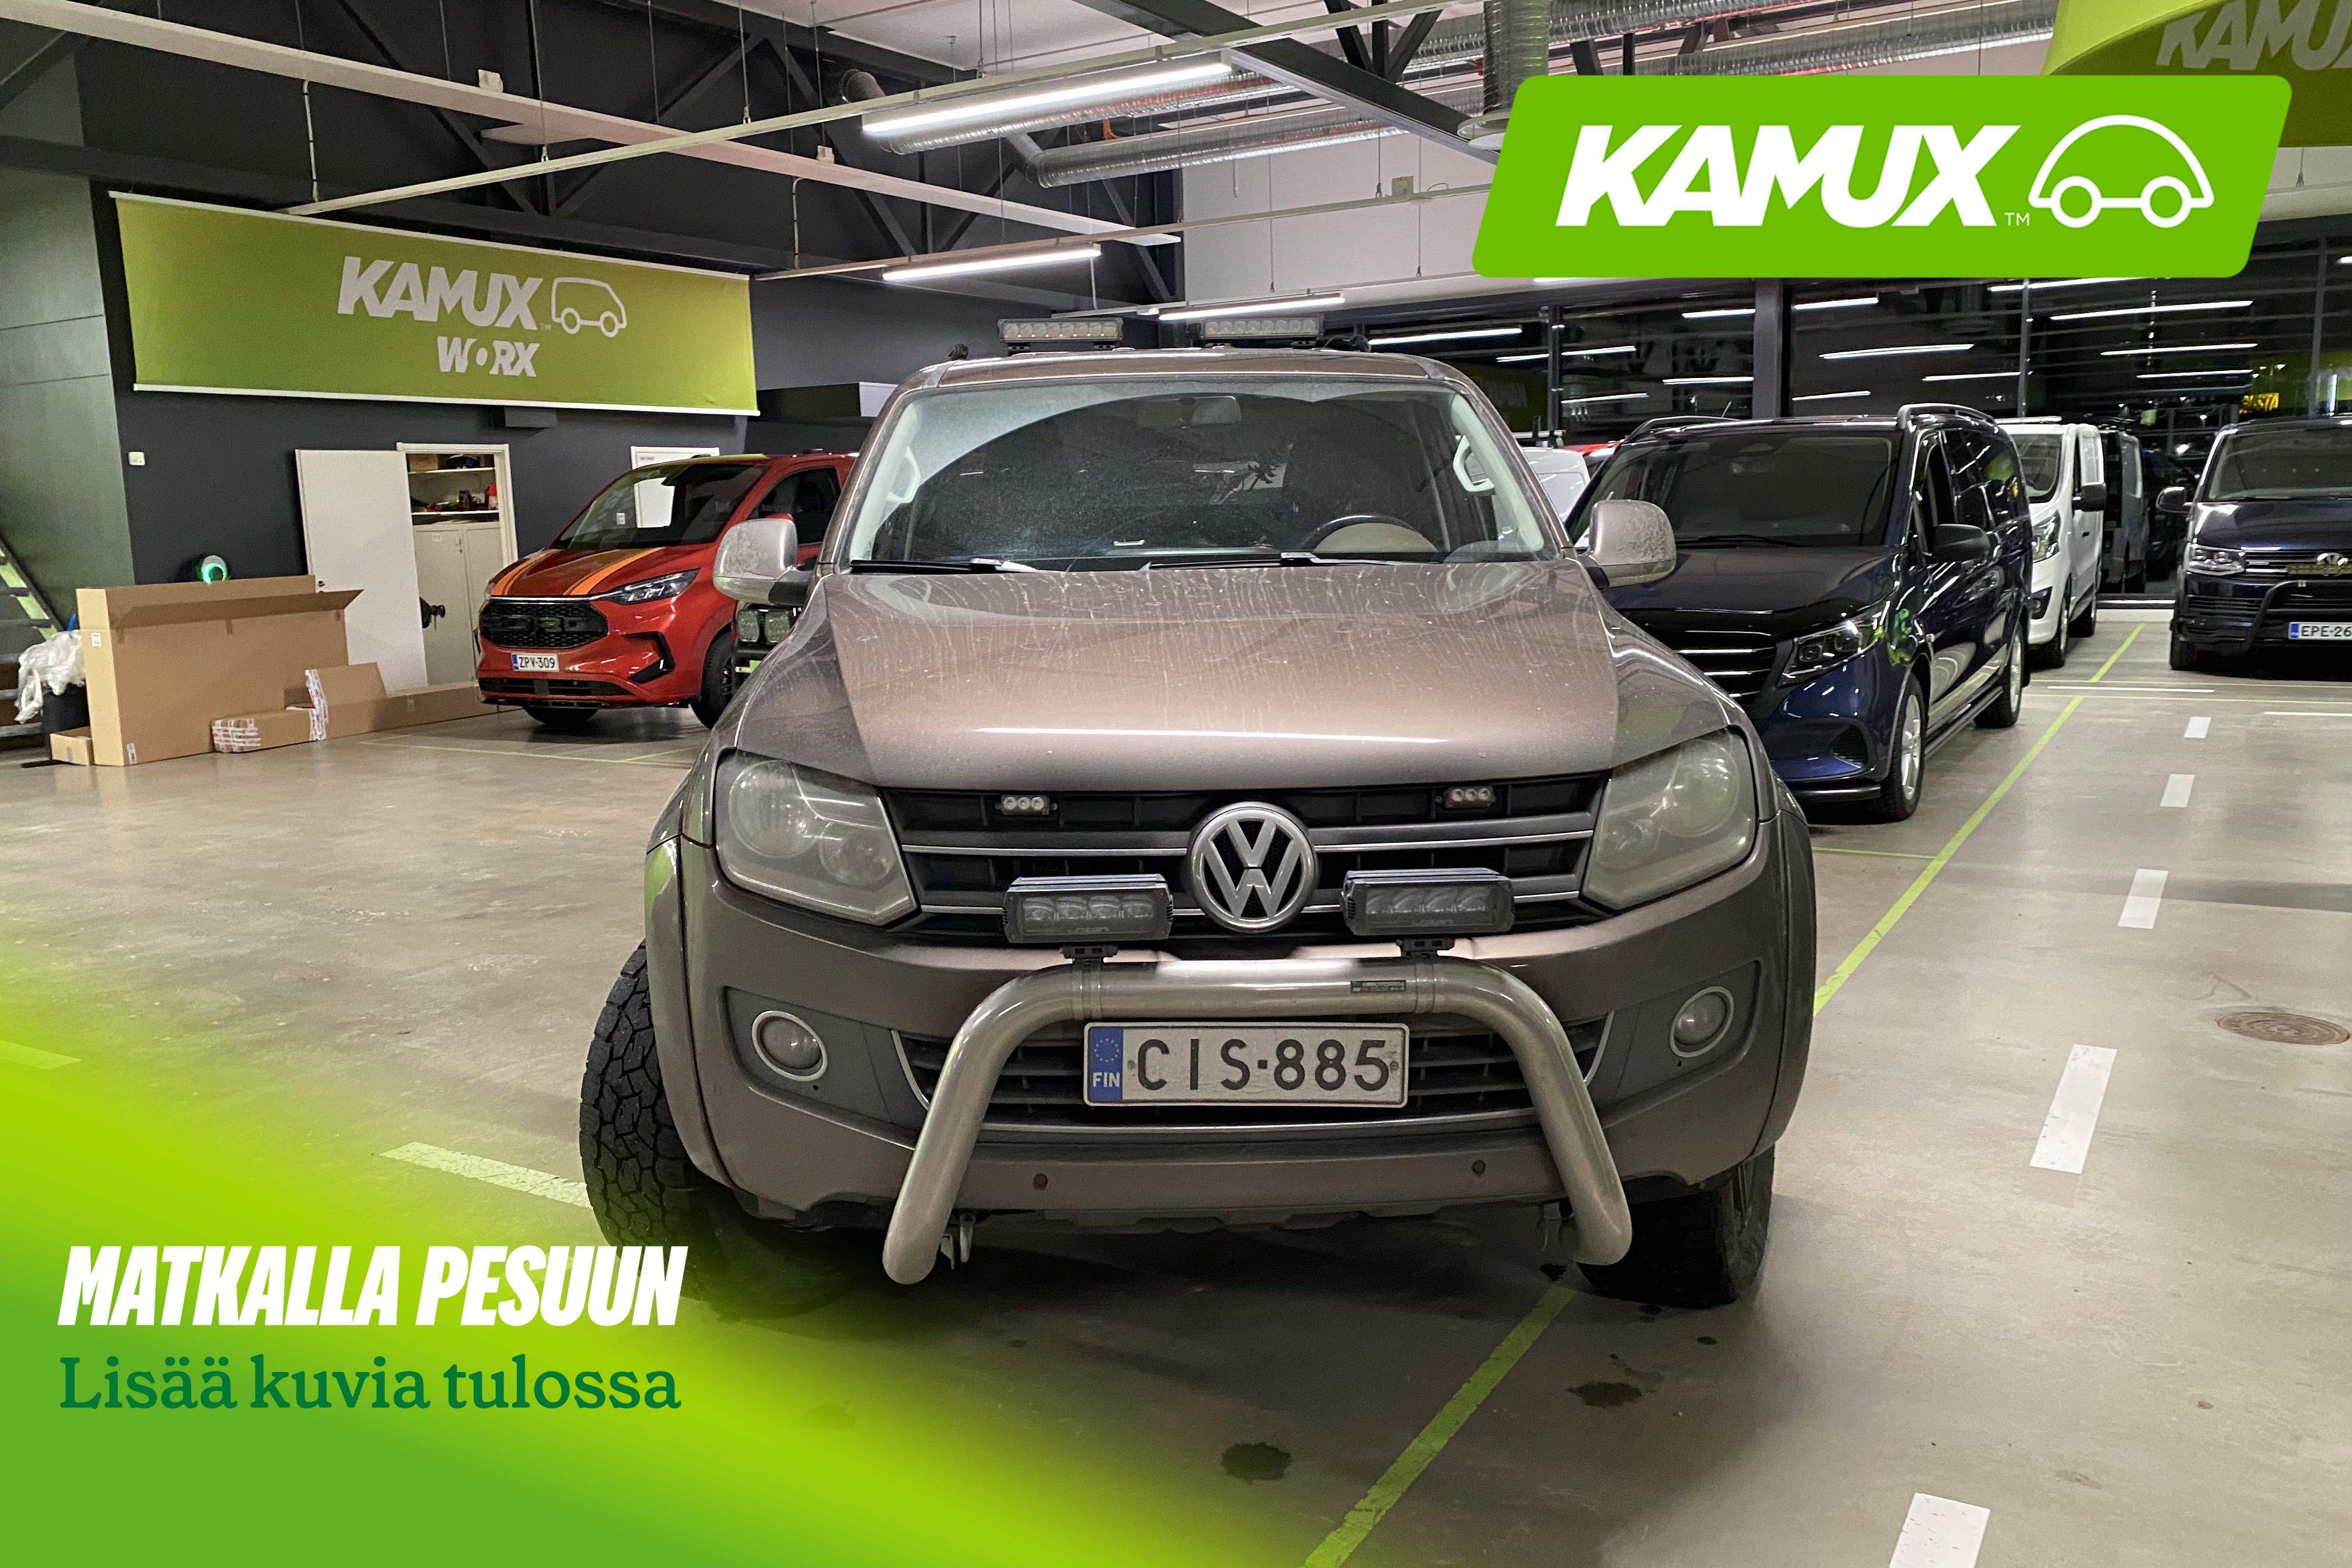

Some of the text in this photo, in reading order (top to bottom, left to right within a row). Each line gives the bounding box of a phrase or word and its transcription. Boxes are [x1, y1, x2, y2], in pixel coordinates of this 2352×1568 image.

[2156, 0, 2352, 71] KAMU
[337, 256, 542, 330] KAMUX
[1092, 1072, 1120, 1087] FIN
